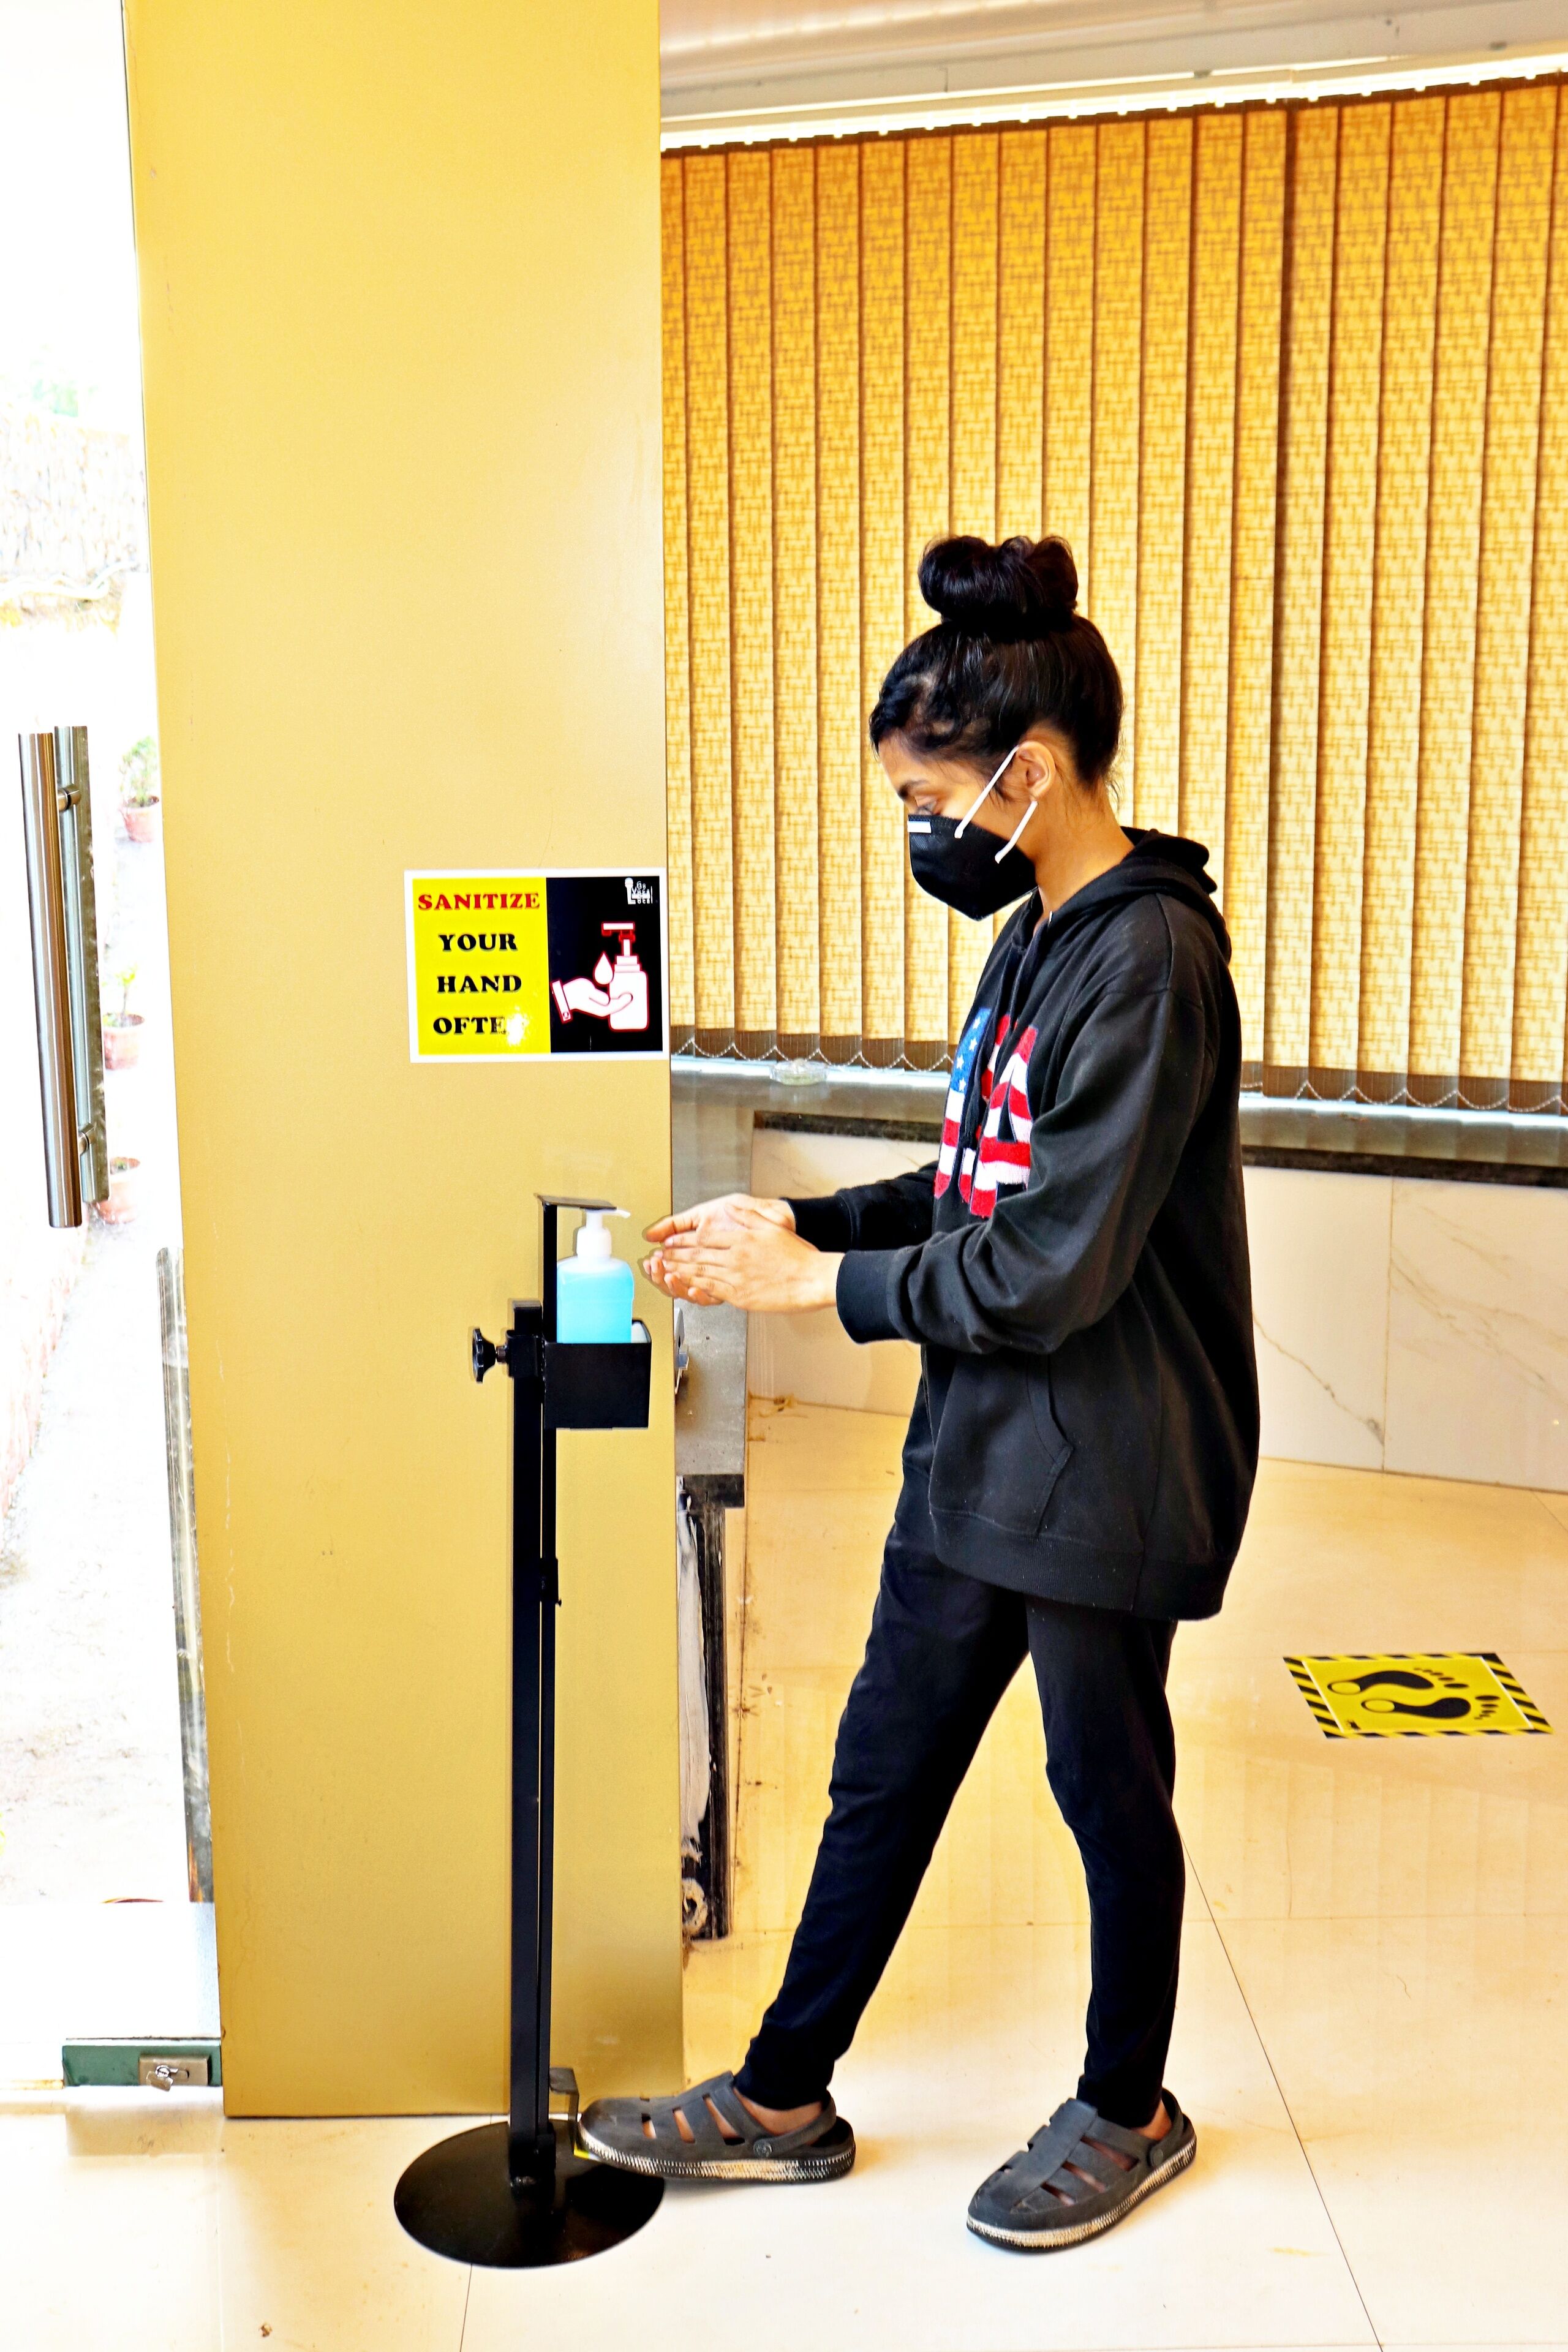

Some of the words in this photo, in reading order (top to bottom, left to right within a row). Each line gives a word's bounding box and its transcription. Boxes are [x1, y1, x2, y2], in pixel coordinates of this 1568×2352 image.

[418, 892, 540, 910] SANITIZE
[439, 933, 518, 951] YOUR
[437, 974, 522, 993] HAND
[433, 1016, 527, 1035] OFTE
